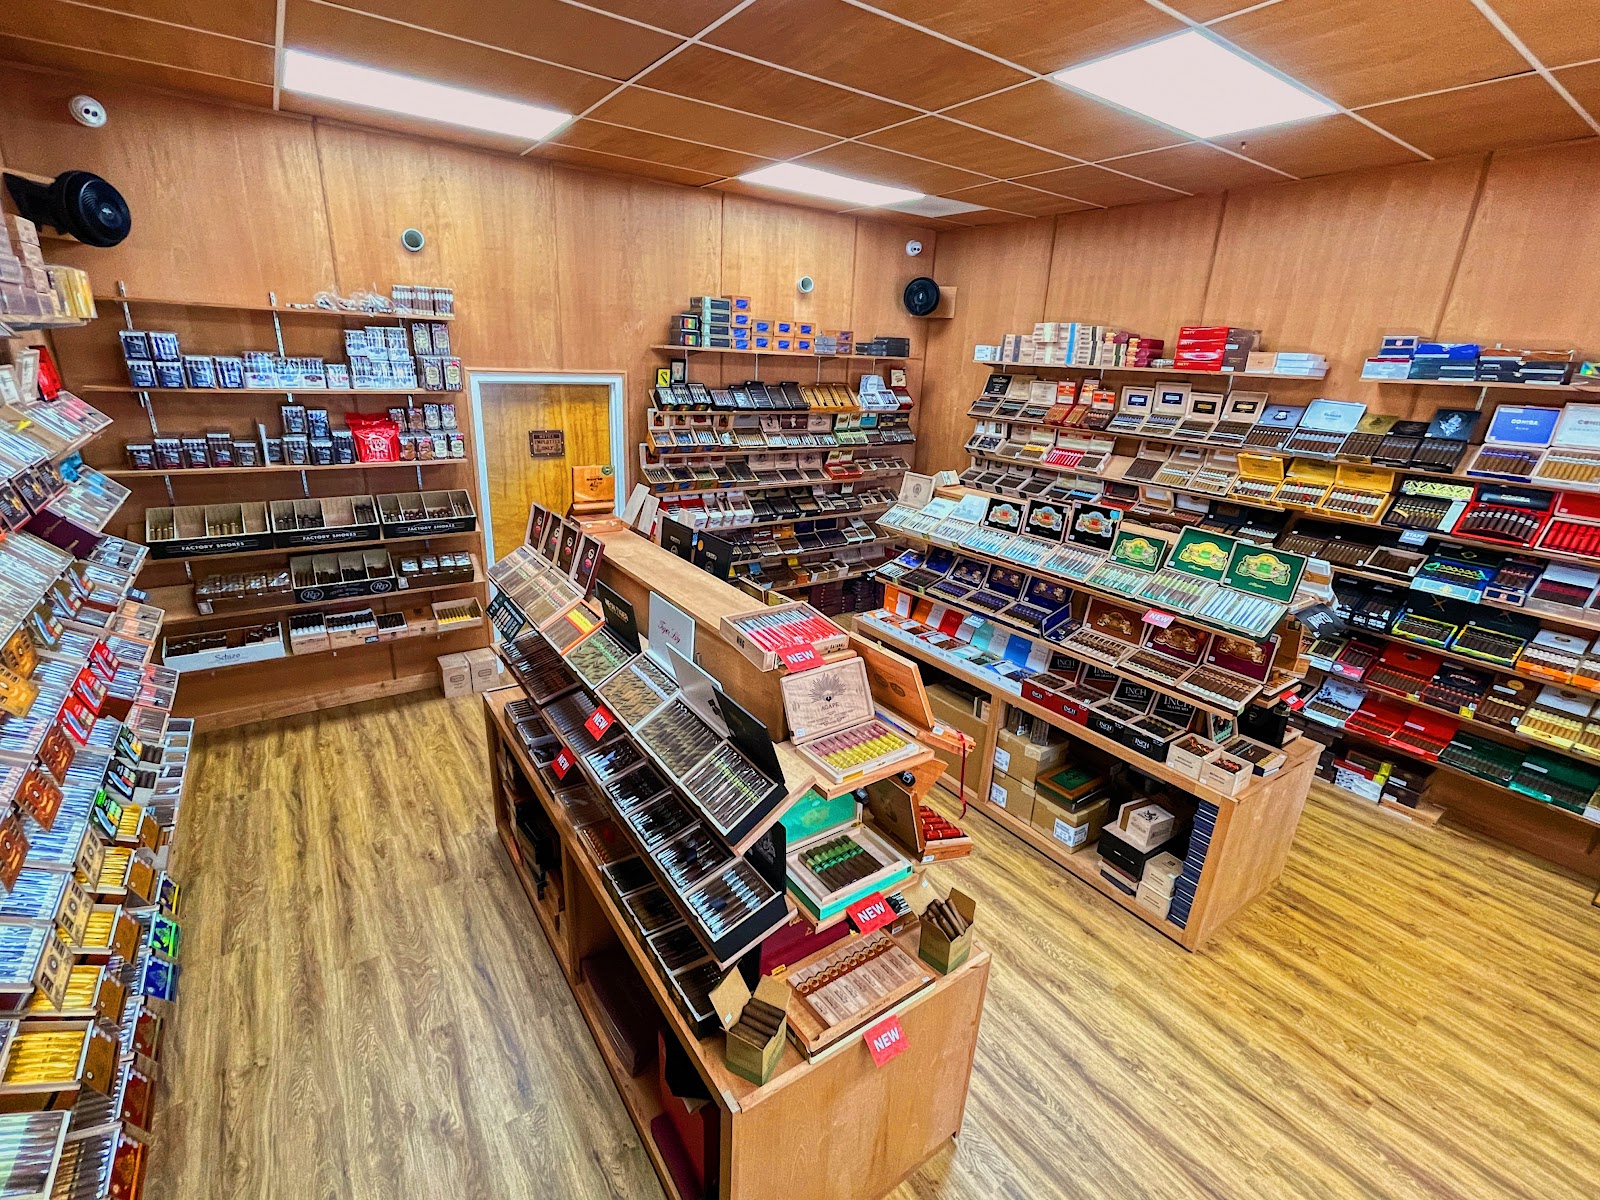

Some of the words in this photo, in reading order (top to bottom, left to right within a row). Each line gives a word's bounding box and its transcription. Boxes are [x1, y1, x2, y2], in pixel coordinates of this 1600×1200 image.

[1148, 612, 1170, 623] NEW
[786, 649, 815, 664] NEW
[1057, 658, 1075, 667] INCH
[1125, 686, 1147, 697] INCH
[821, 702, 840, 711] AGAPE
[592, 712, 609, 730] NEW
[1134, 737, 1150, 749] INCH
[556, 753, 570, 771] NEW
[857, 901, 886, 924] NEW
[873, 1026, 900, 1053] NEW
